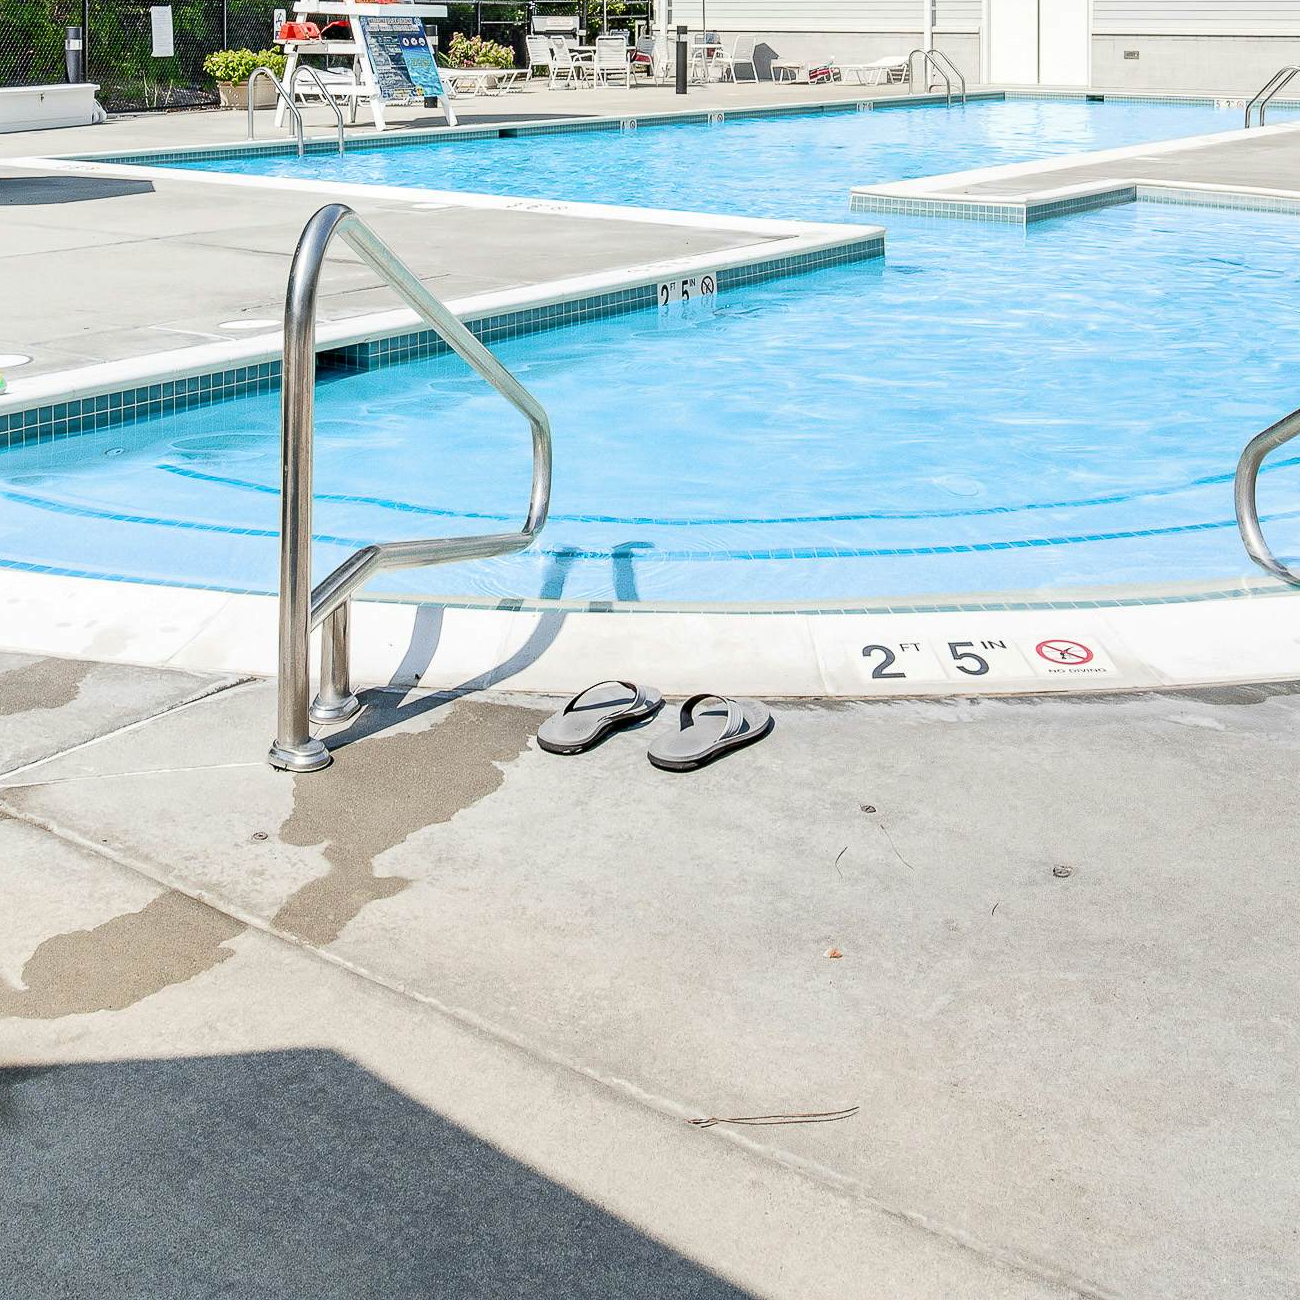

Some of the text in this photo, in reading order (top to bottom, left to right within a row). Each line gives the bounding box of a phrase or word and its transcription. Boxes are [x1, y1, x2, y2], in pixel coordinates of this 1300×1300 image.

[660, 284, 669, 306] 2
[670, 282, 676, 291] FT
[681, 279, 690, 300] 5
[861, 640, 1007, 679] 2 FT 5 IN
